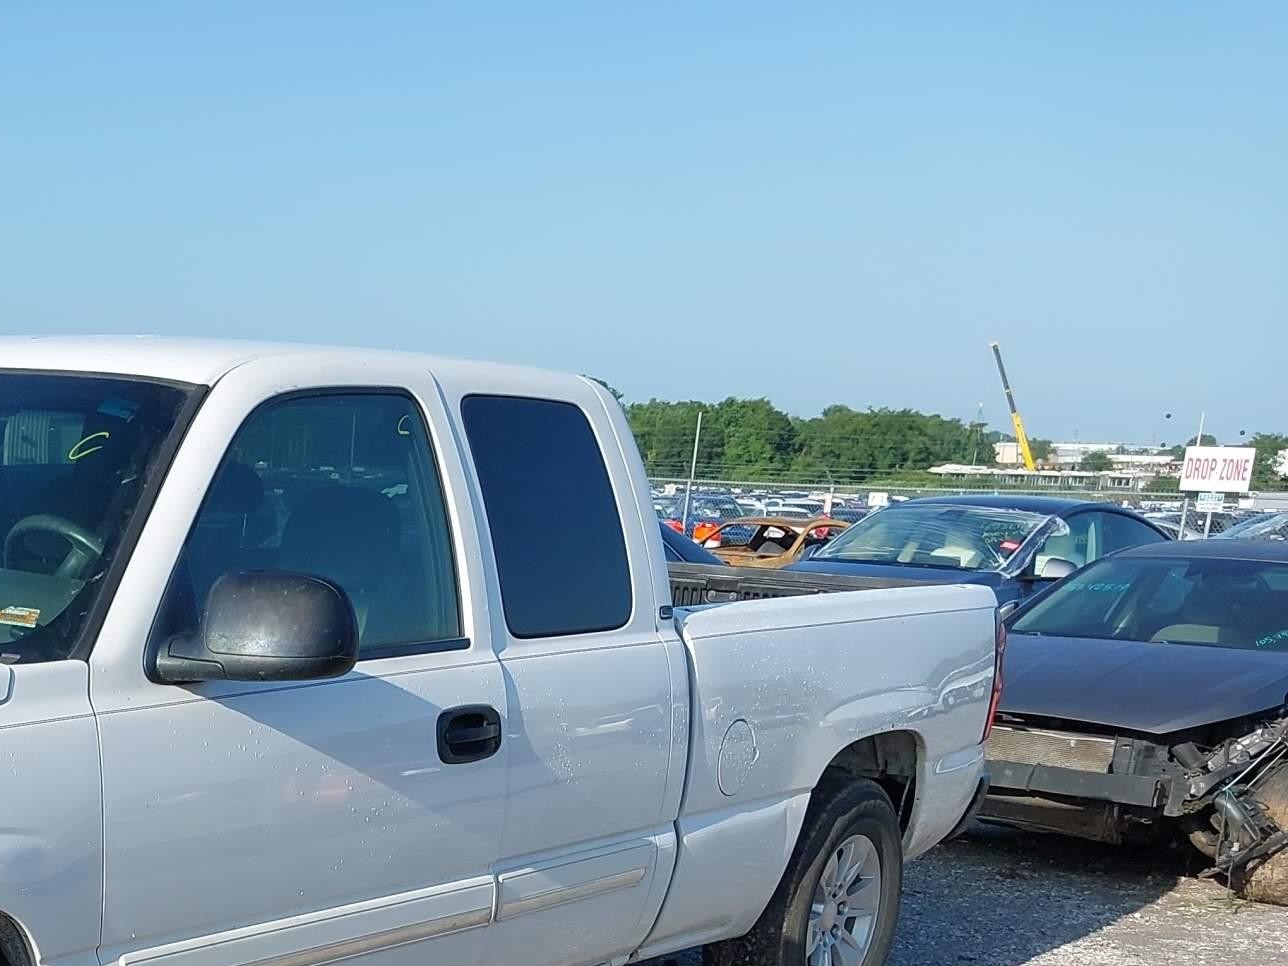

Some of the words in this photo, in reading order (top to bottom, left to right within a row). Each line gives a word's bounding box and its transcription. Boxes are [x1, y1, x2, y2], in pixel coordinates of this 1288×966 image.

[68, 431, 110, 460] C
[1185, 457, 1218, 480] DROP
[1219, 458, 1250, 481] ZONE
